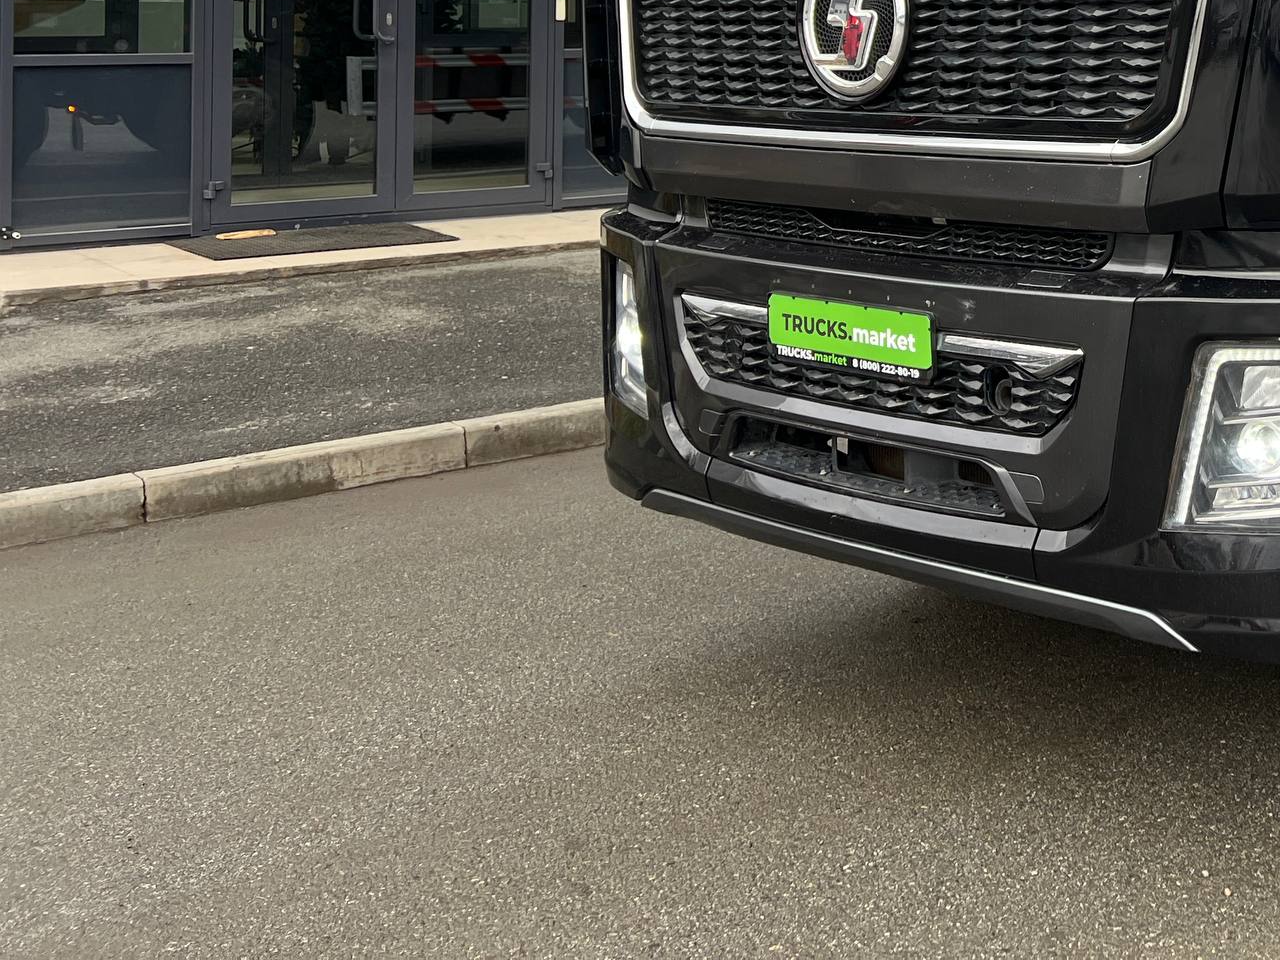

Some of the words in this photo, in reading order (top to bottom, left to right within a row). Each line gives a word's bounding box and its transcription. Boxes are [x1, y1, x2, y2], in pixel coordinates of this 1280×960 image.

[782, 312, 917, 353] TRUCKS.market
[776, 344, 848, 366] TRUCKS.market
[852, 358, 859, 368] 8
[859, 359, 880, 372] (800)
[881, 363, 920, 379] 222-80-19
